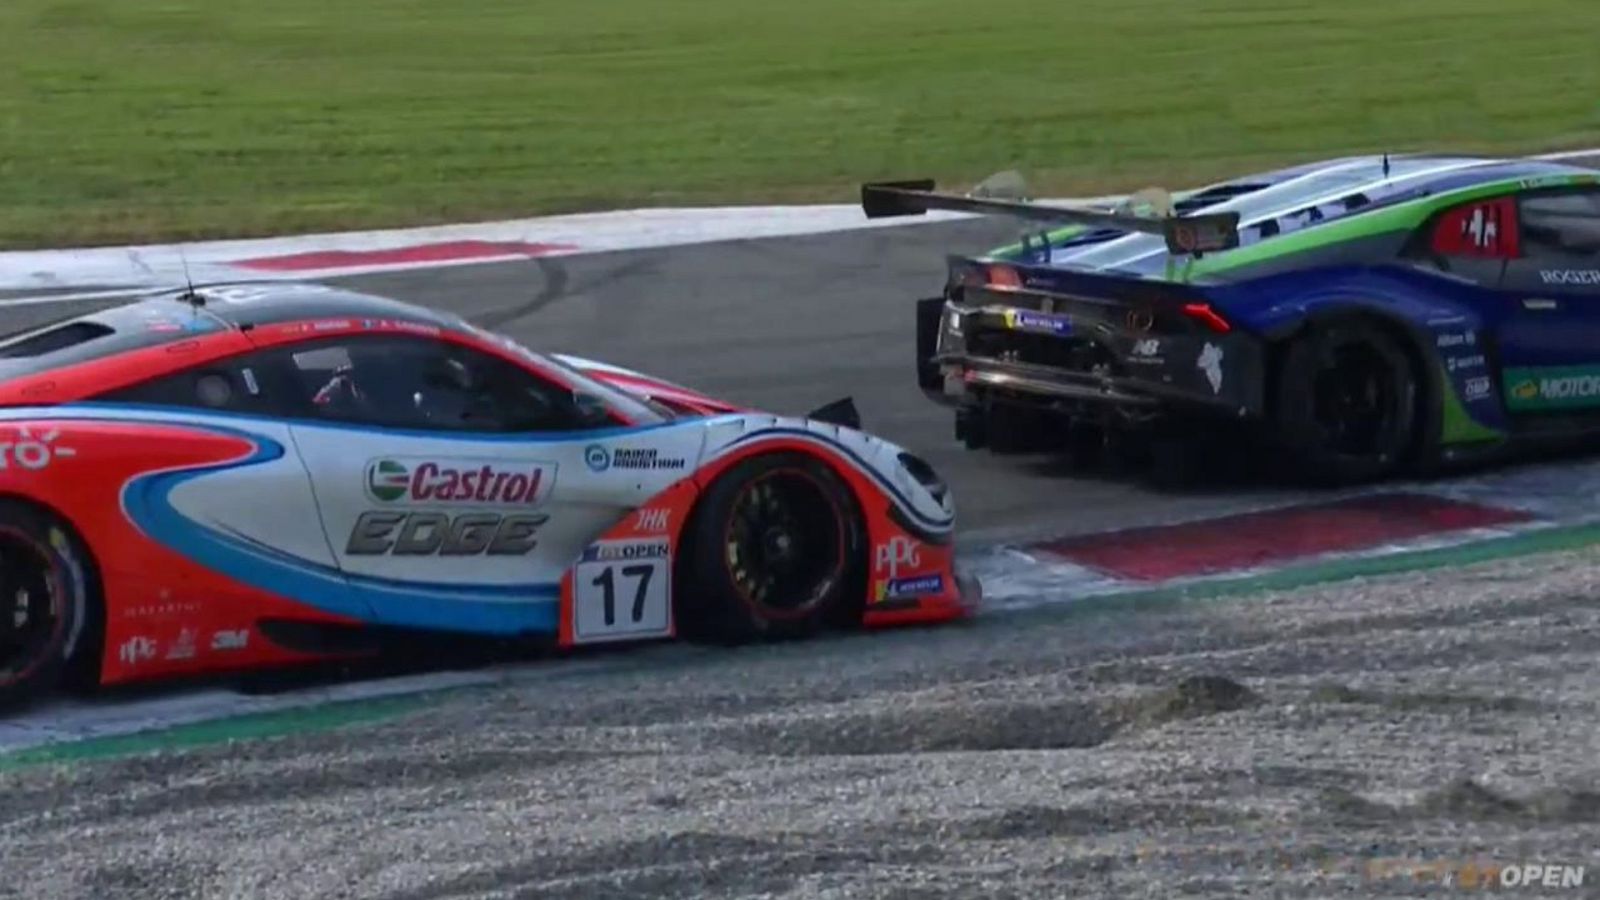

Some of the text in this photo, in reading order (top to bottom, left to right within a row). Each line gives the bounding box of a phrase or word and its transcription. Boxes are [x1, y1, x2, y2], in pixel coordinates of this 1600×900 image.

[410, 461, 543, 502] Castrol
[346, 510, 550, 556] EDGE
[632, 508, 672, 532] JHK
[591, 563, 655, 627] 17
[210, 629, 250, 650] 3M
